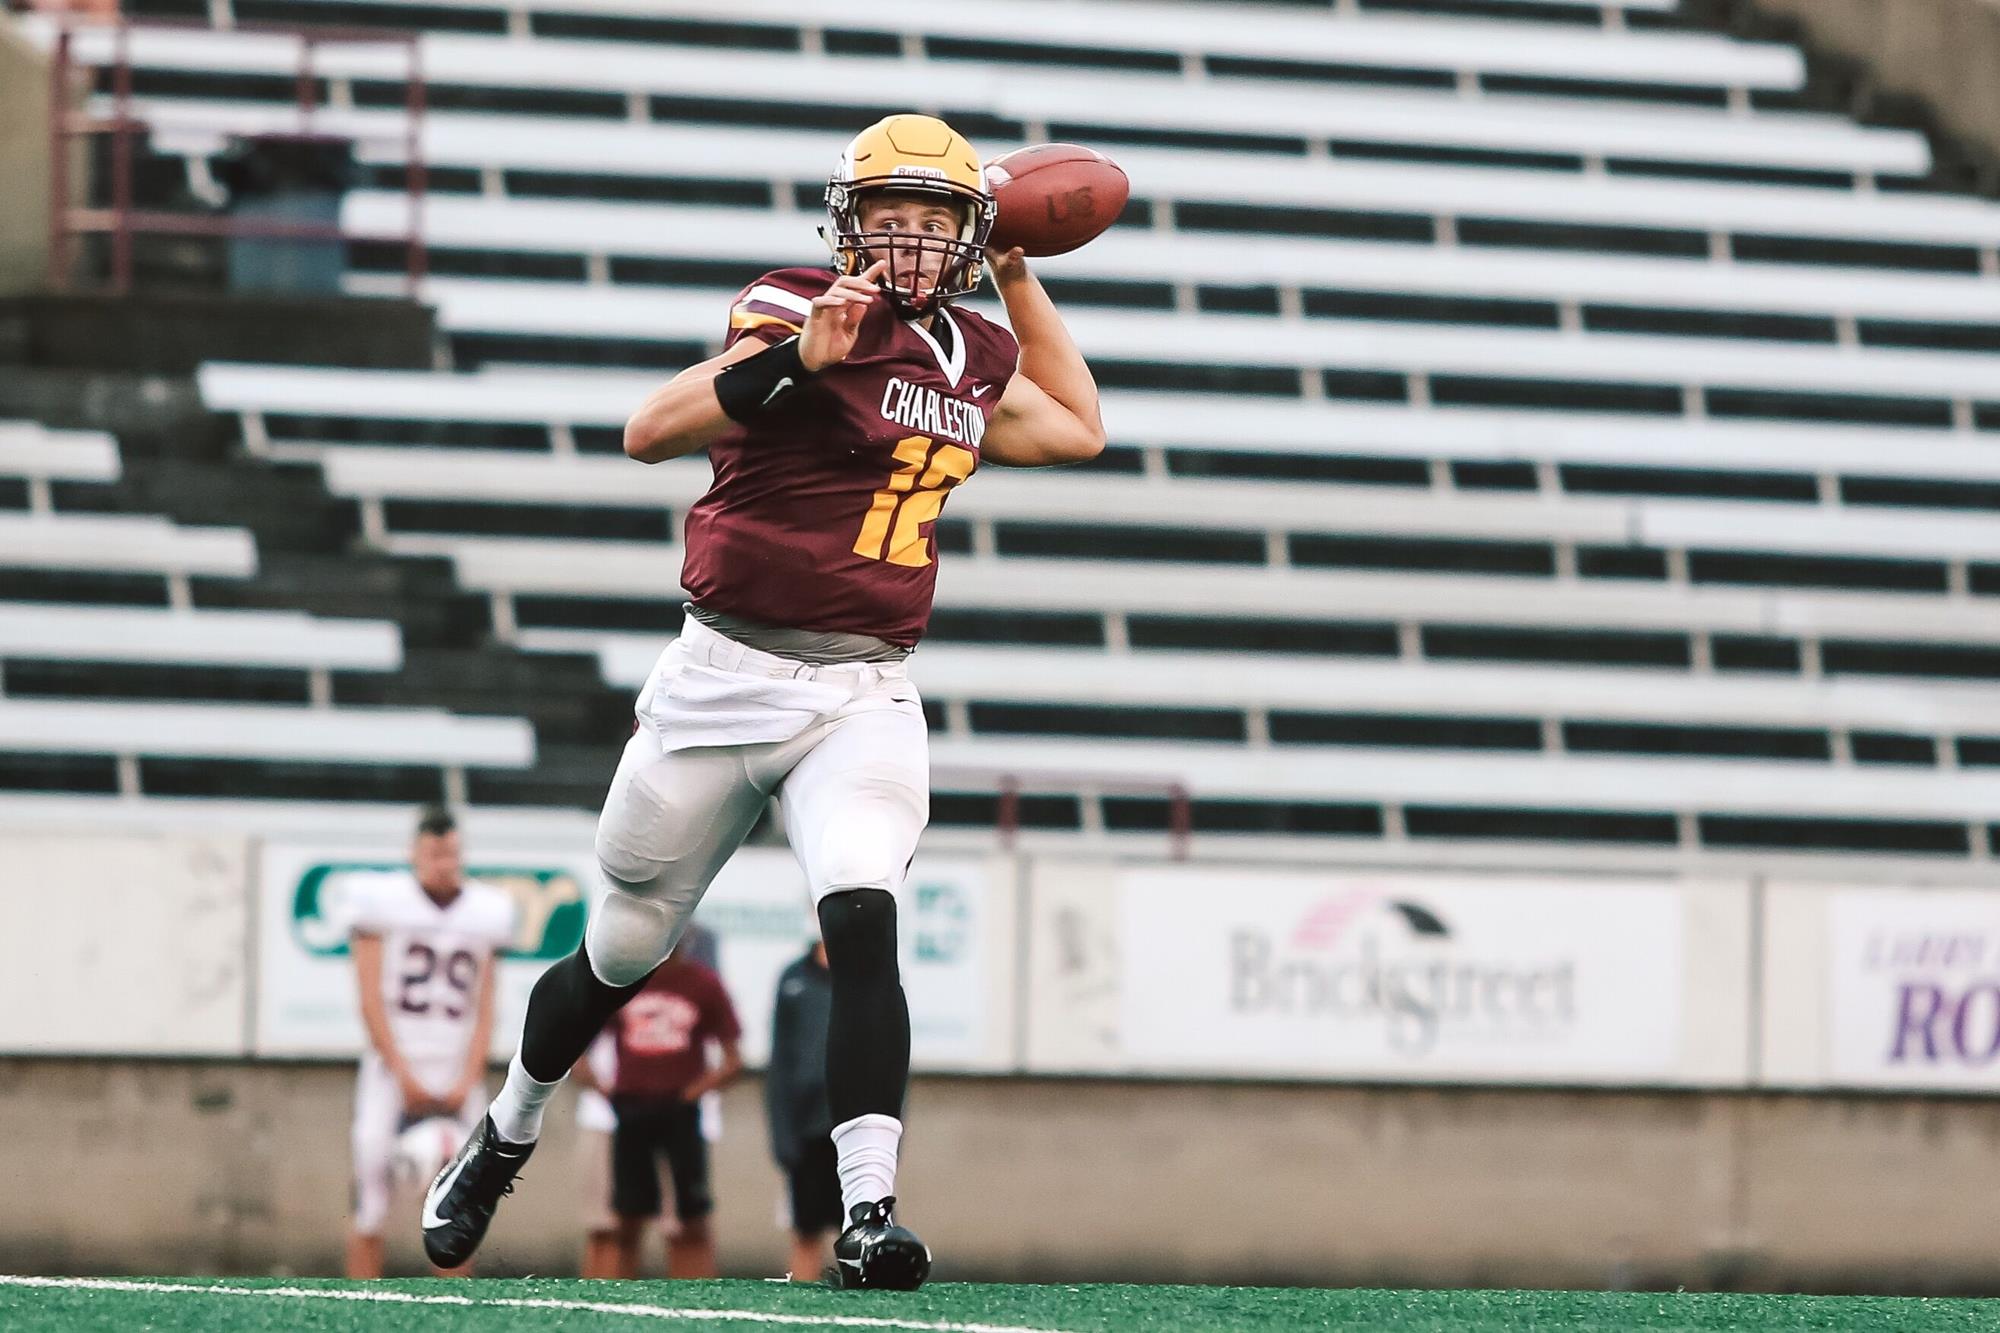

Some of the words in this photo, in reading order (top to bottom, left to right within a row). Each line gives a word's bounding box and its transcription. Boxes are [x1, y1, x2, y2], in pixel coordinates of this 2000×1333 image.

[898, 167, 942, 179] Riddell
[880, 377, 986, 448] CHARLESTON
[852, 435, 975, 568] 12
[401, 943, 479, 1018] 29
